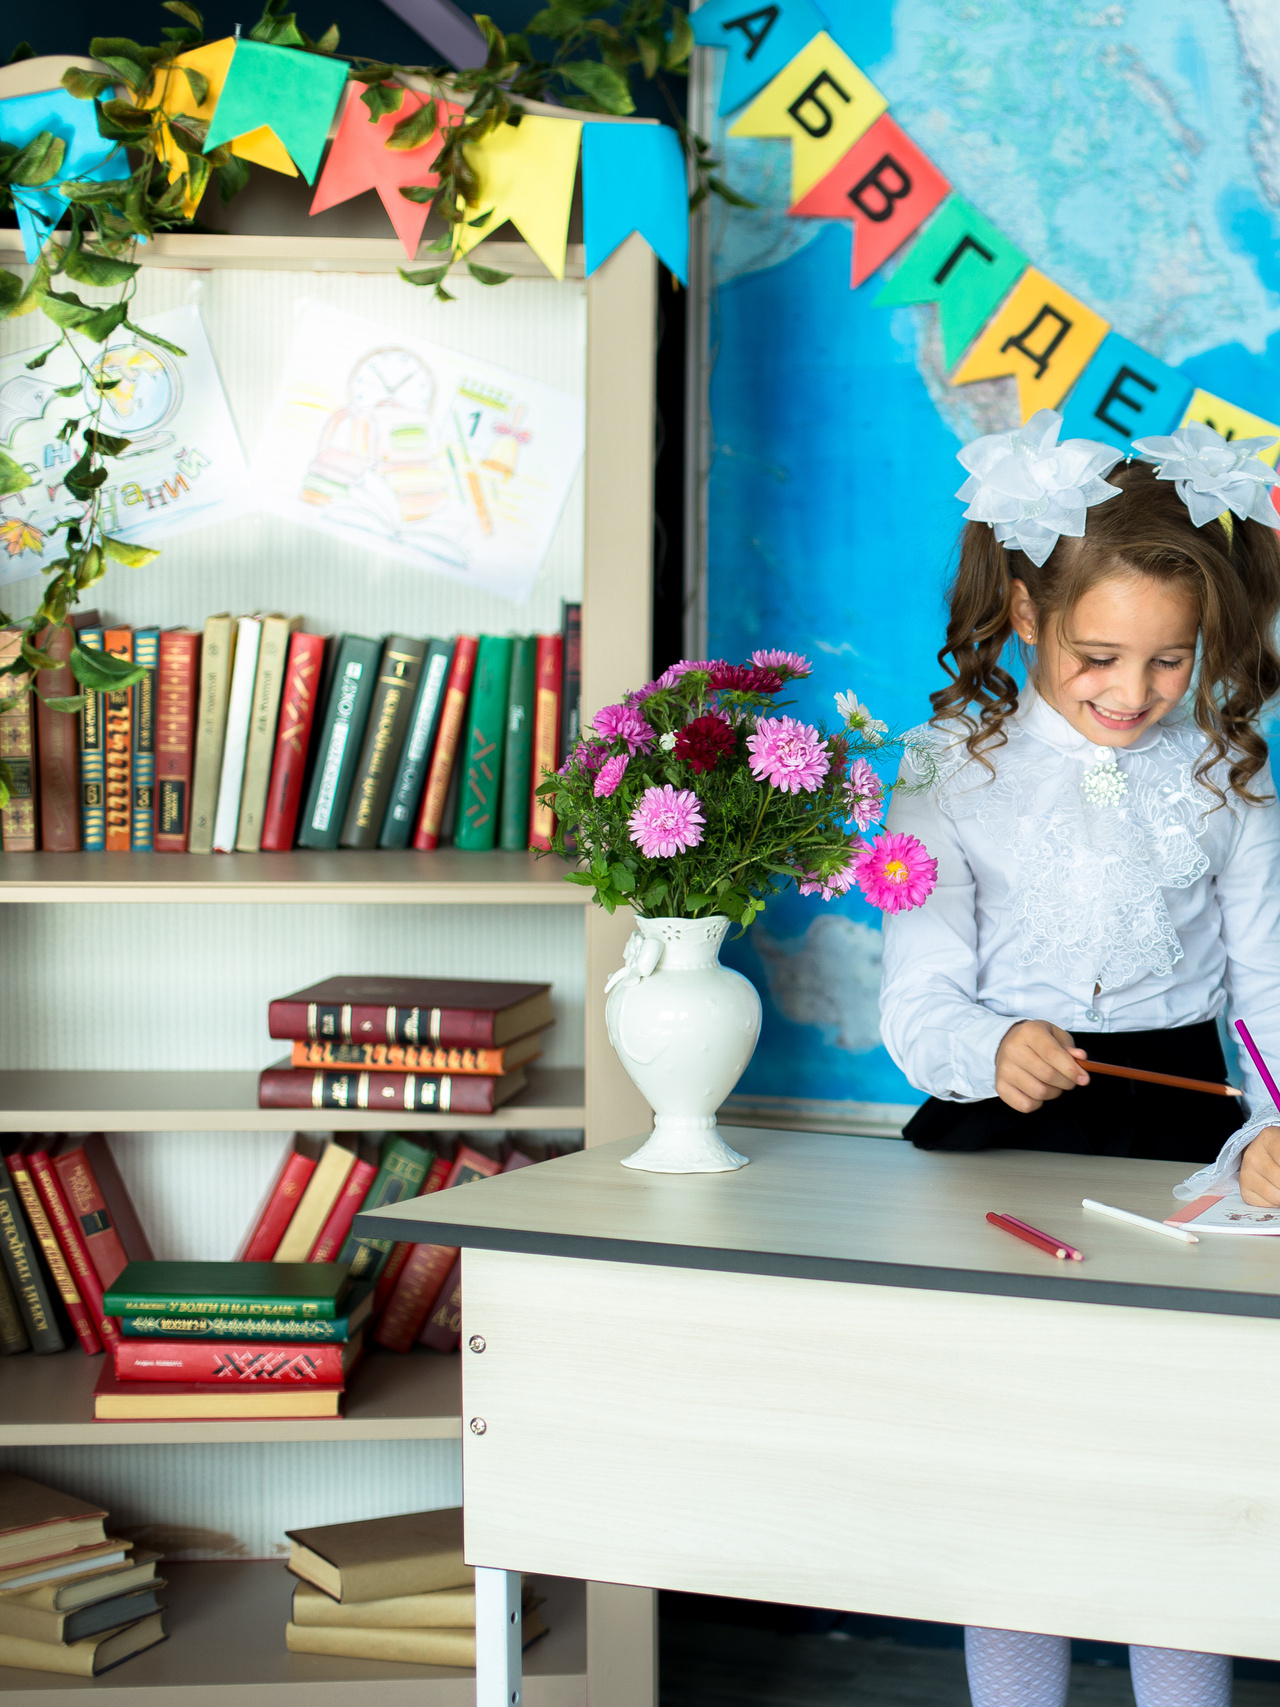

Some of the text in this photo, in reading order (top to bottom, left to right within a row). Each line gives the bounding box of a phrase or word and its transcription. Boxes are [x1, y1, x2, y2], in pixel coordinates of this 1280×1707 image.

[722, 5, 779, 60] А
[788, 71, 850, 138] Б
[848, 155, 911, 222] В
[934, 235, 996, 284] Г
[1001, 305, 1072, 379] Д
[1095, 366, 1156, 437] Е
[0, 1198, 50, 1333] ЮРИЙ ТРИФОНОВ
[178, 1302, 218, 1313] ВОЛГИ
[230, 1303, 247, 1314] НА
